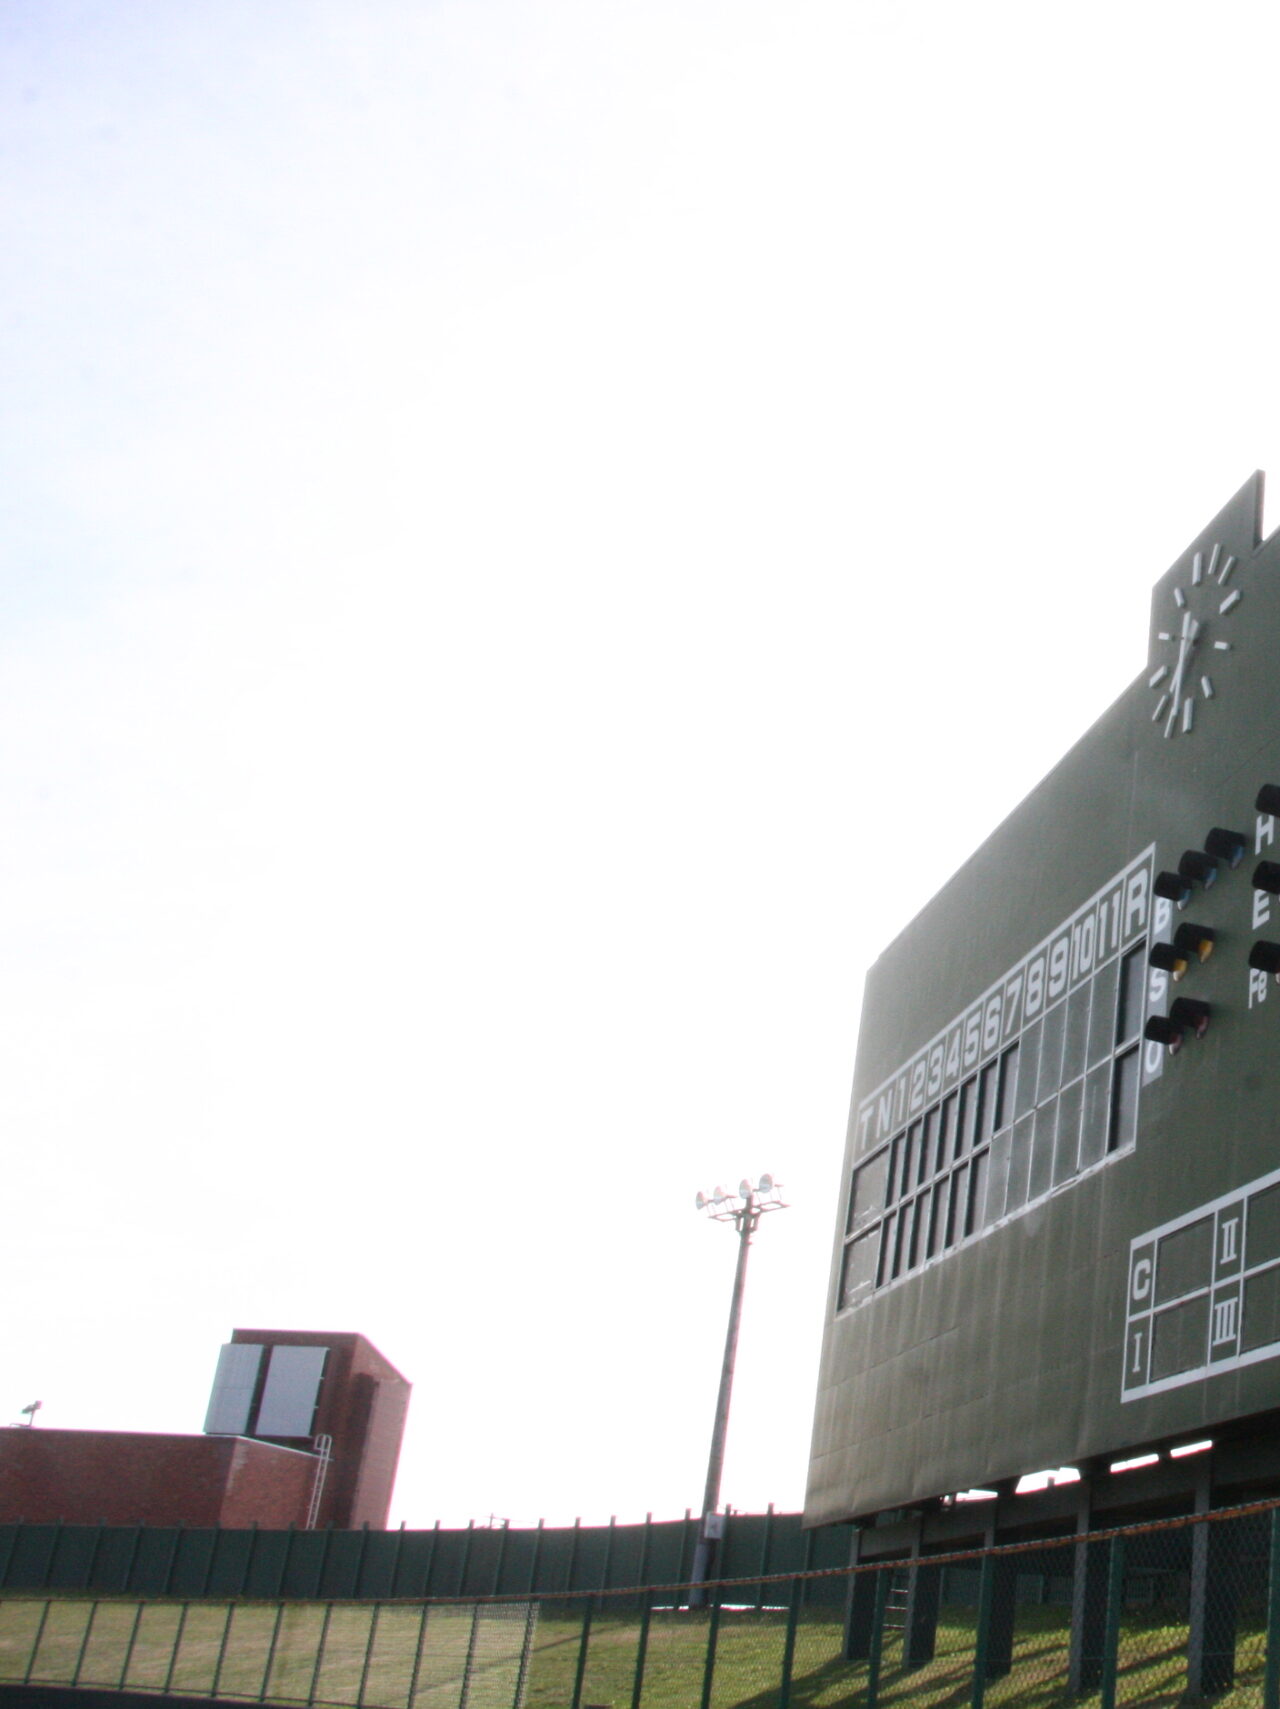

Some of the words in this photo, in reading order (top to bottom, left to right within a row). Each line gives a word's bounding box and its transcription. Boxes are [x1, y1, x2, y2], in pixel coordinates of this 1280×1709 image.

[1254, 814, 1275, 856] H
[1153, 896, 1171, 935] B
[1252, 889, 1270, 930] E
[898, 1076, 906, 1121] 1
[910, 1060, 926, 1112] 2
[928, 1044, 944, 1096] 3
[946, 1029, 961, 1077] 4
[964, 1011, 981, 1067] 5
[983, 995, 1001, 1051] 6
[1005, 974, 1023, 1036] 7
[1026, 957, 1044, 1017] 8
[1049, 937, 1069, 997] 9
[1072, 913, 1097, 981] 10
[1099, 890, 1121, 959] 11
[1125, 868, 1148, 937] R
[1150, 968, 1167, 1002] S
[1220, 1217, 1239, 1265] II
[1132, 1258, 1151, 1300] C
[1212, 1297, 1238, 1347] III
